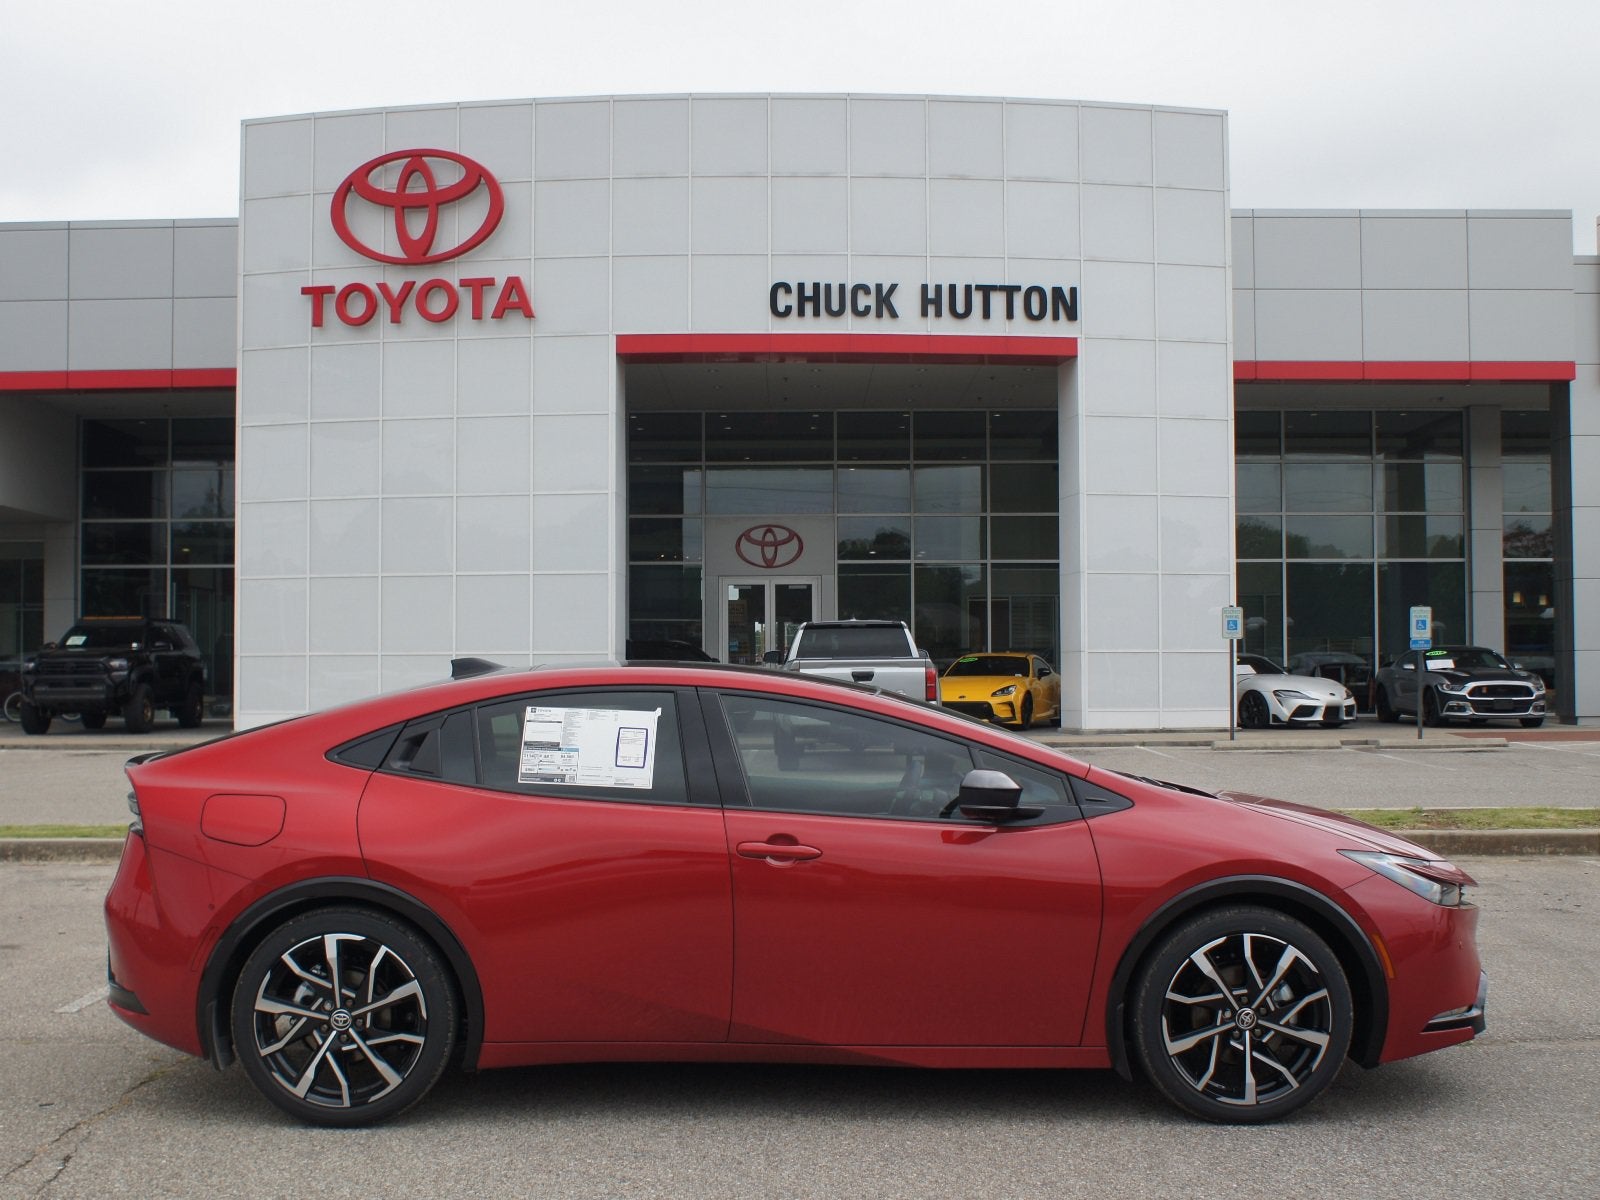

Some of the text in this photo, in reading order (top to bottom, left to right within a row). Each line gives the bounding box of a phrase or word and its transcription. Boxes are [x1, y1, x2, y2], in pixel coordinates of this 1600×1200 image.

[301, 276, 536, 328] TOYOTA
[769, 281, 1079, 321] CHUCK HUTTON
